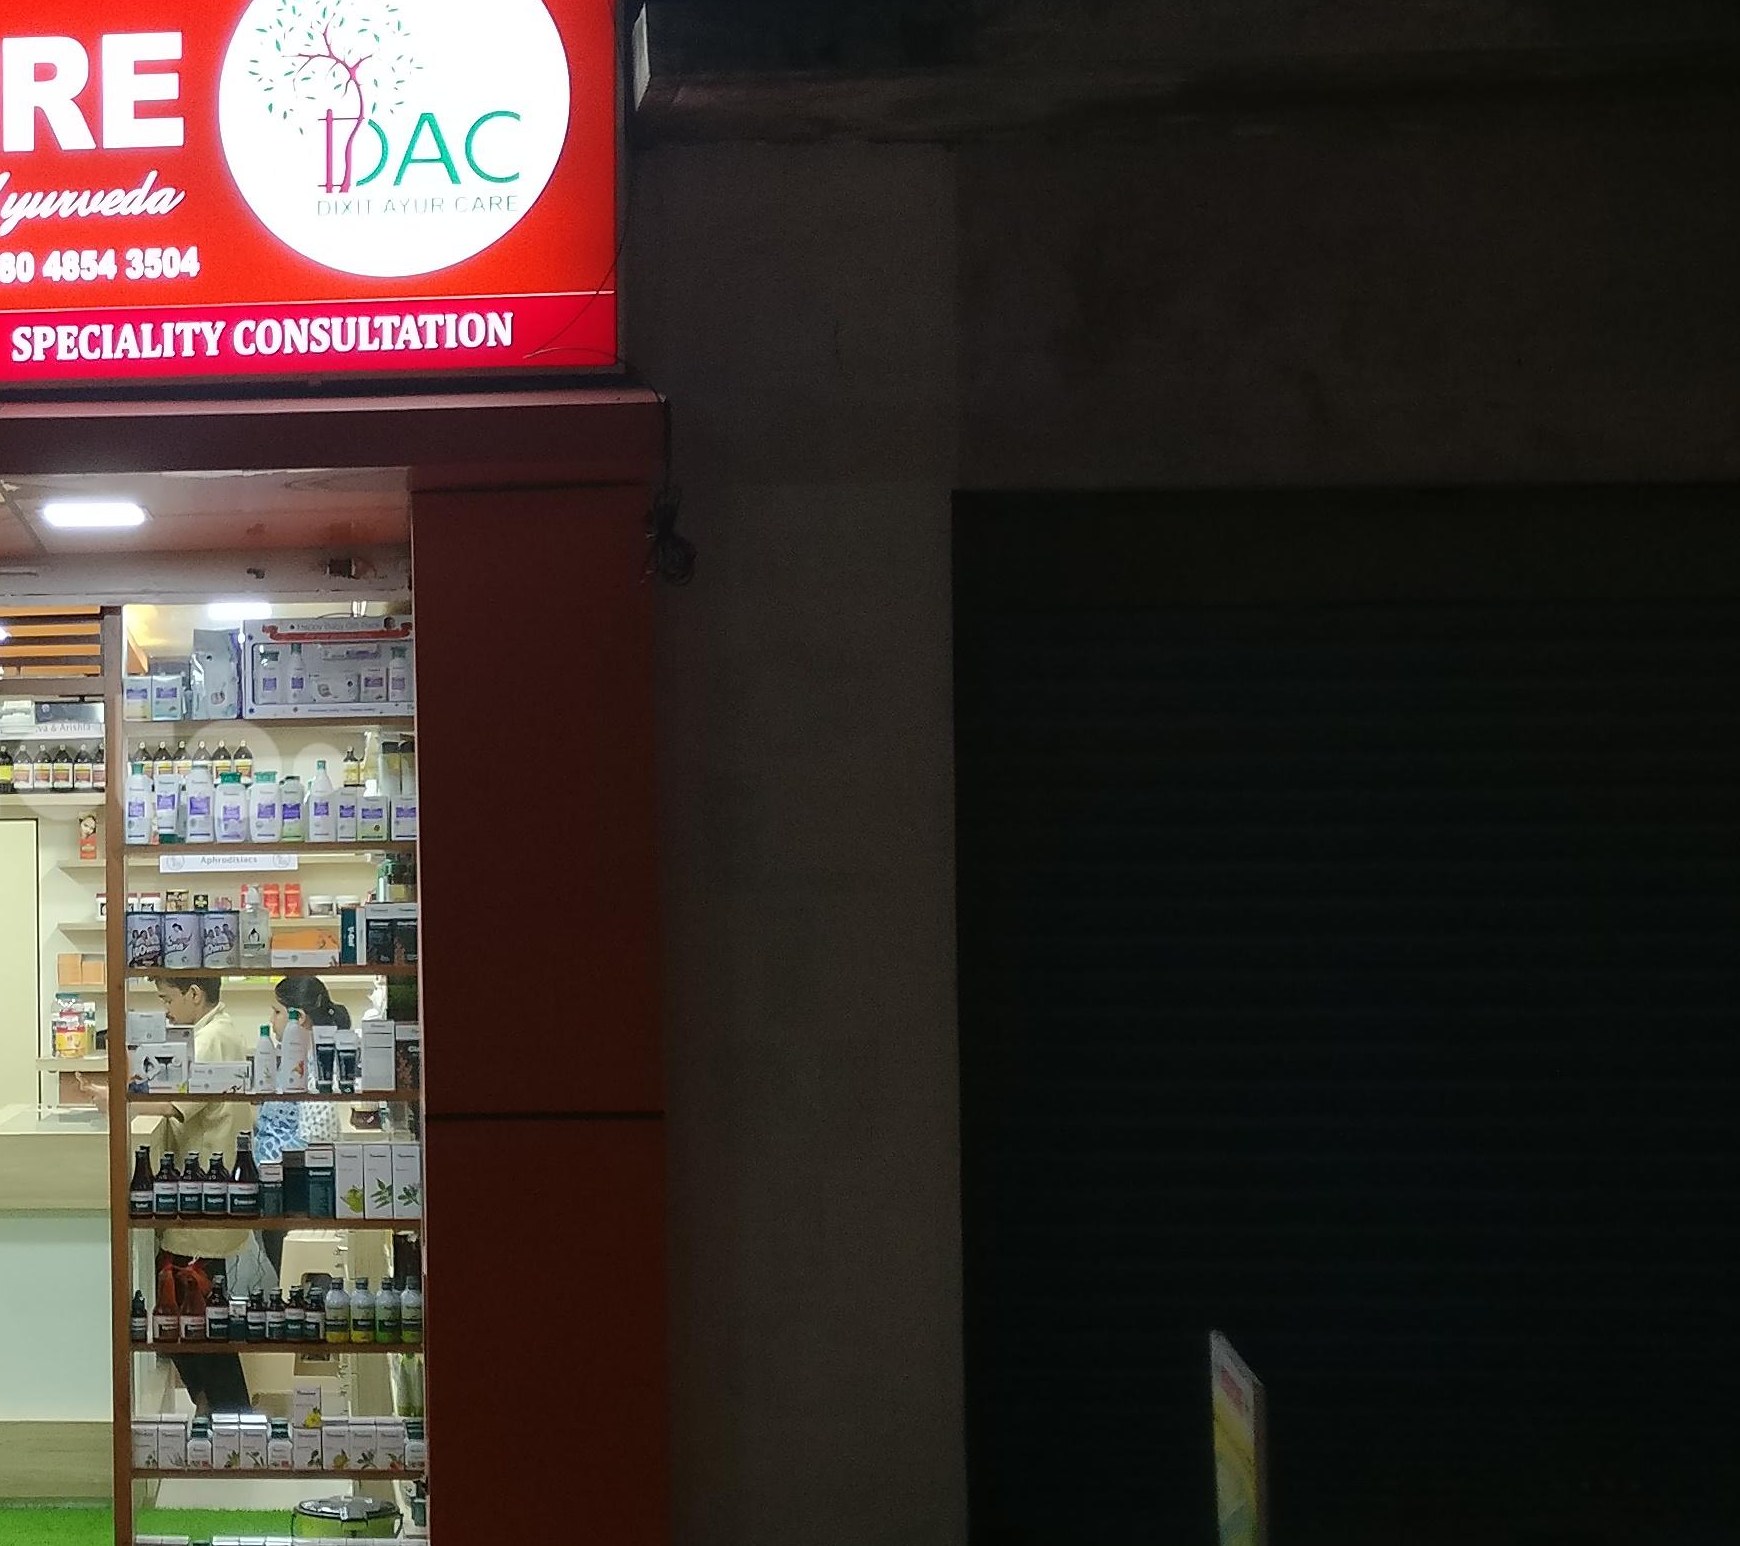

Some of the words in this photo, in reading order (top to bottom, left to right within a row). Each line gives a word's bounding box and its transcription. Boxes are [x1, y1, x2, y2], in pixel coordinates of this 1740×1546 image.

[318, 199, 371, 217] DIXIT
[383, 197, 445, 215] AYUR
[454, 195, 519, 213] CARE
[41, 248, 118, 282] 4854
[124, 245, 201, 280] 3504
[11, 320, 226, 362] SPECIALITY
[233, 312, 514, 356] CONSULTATION
